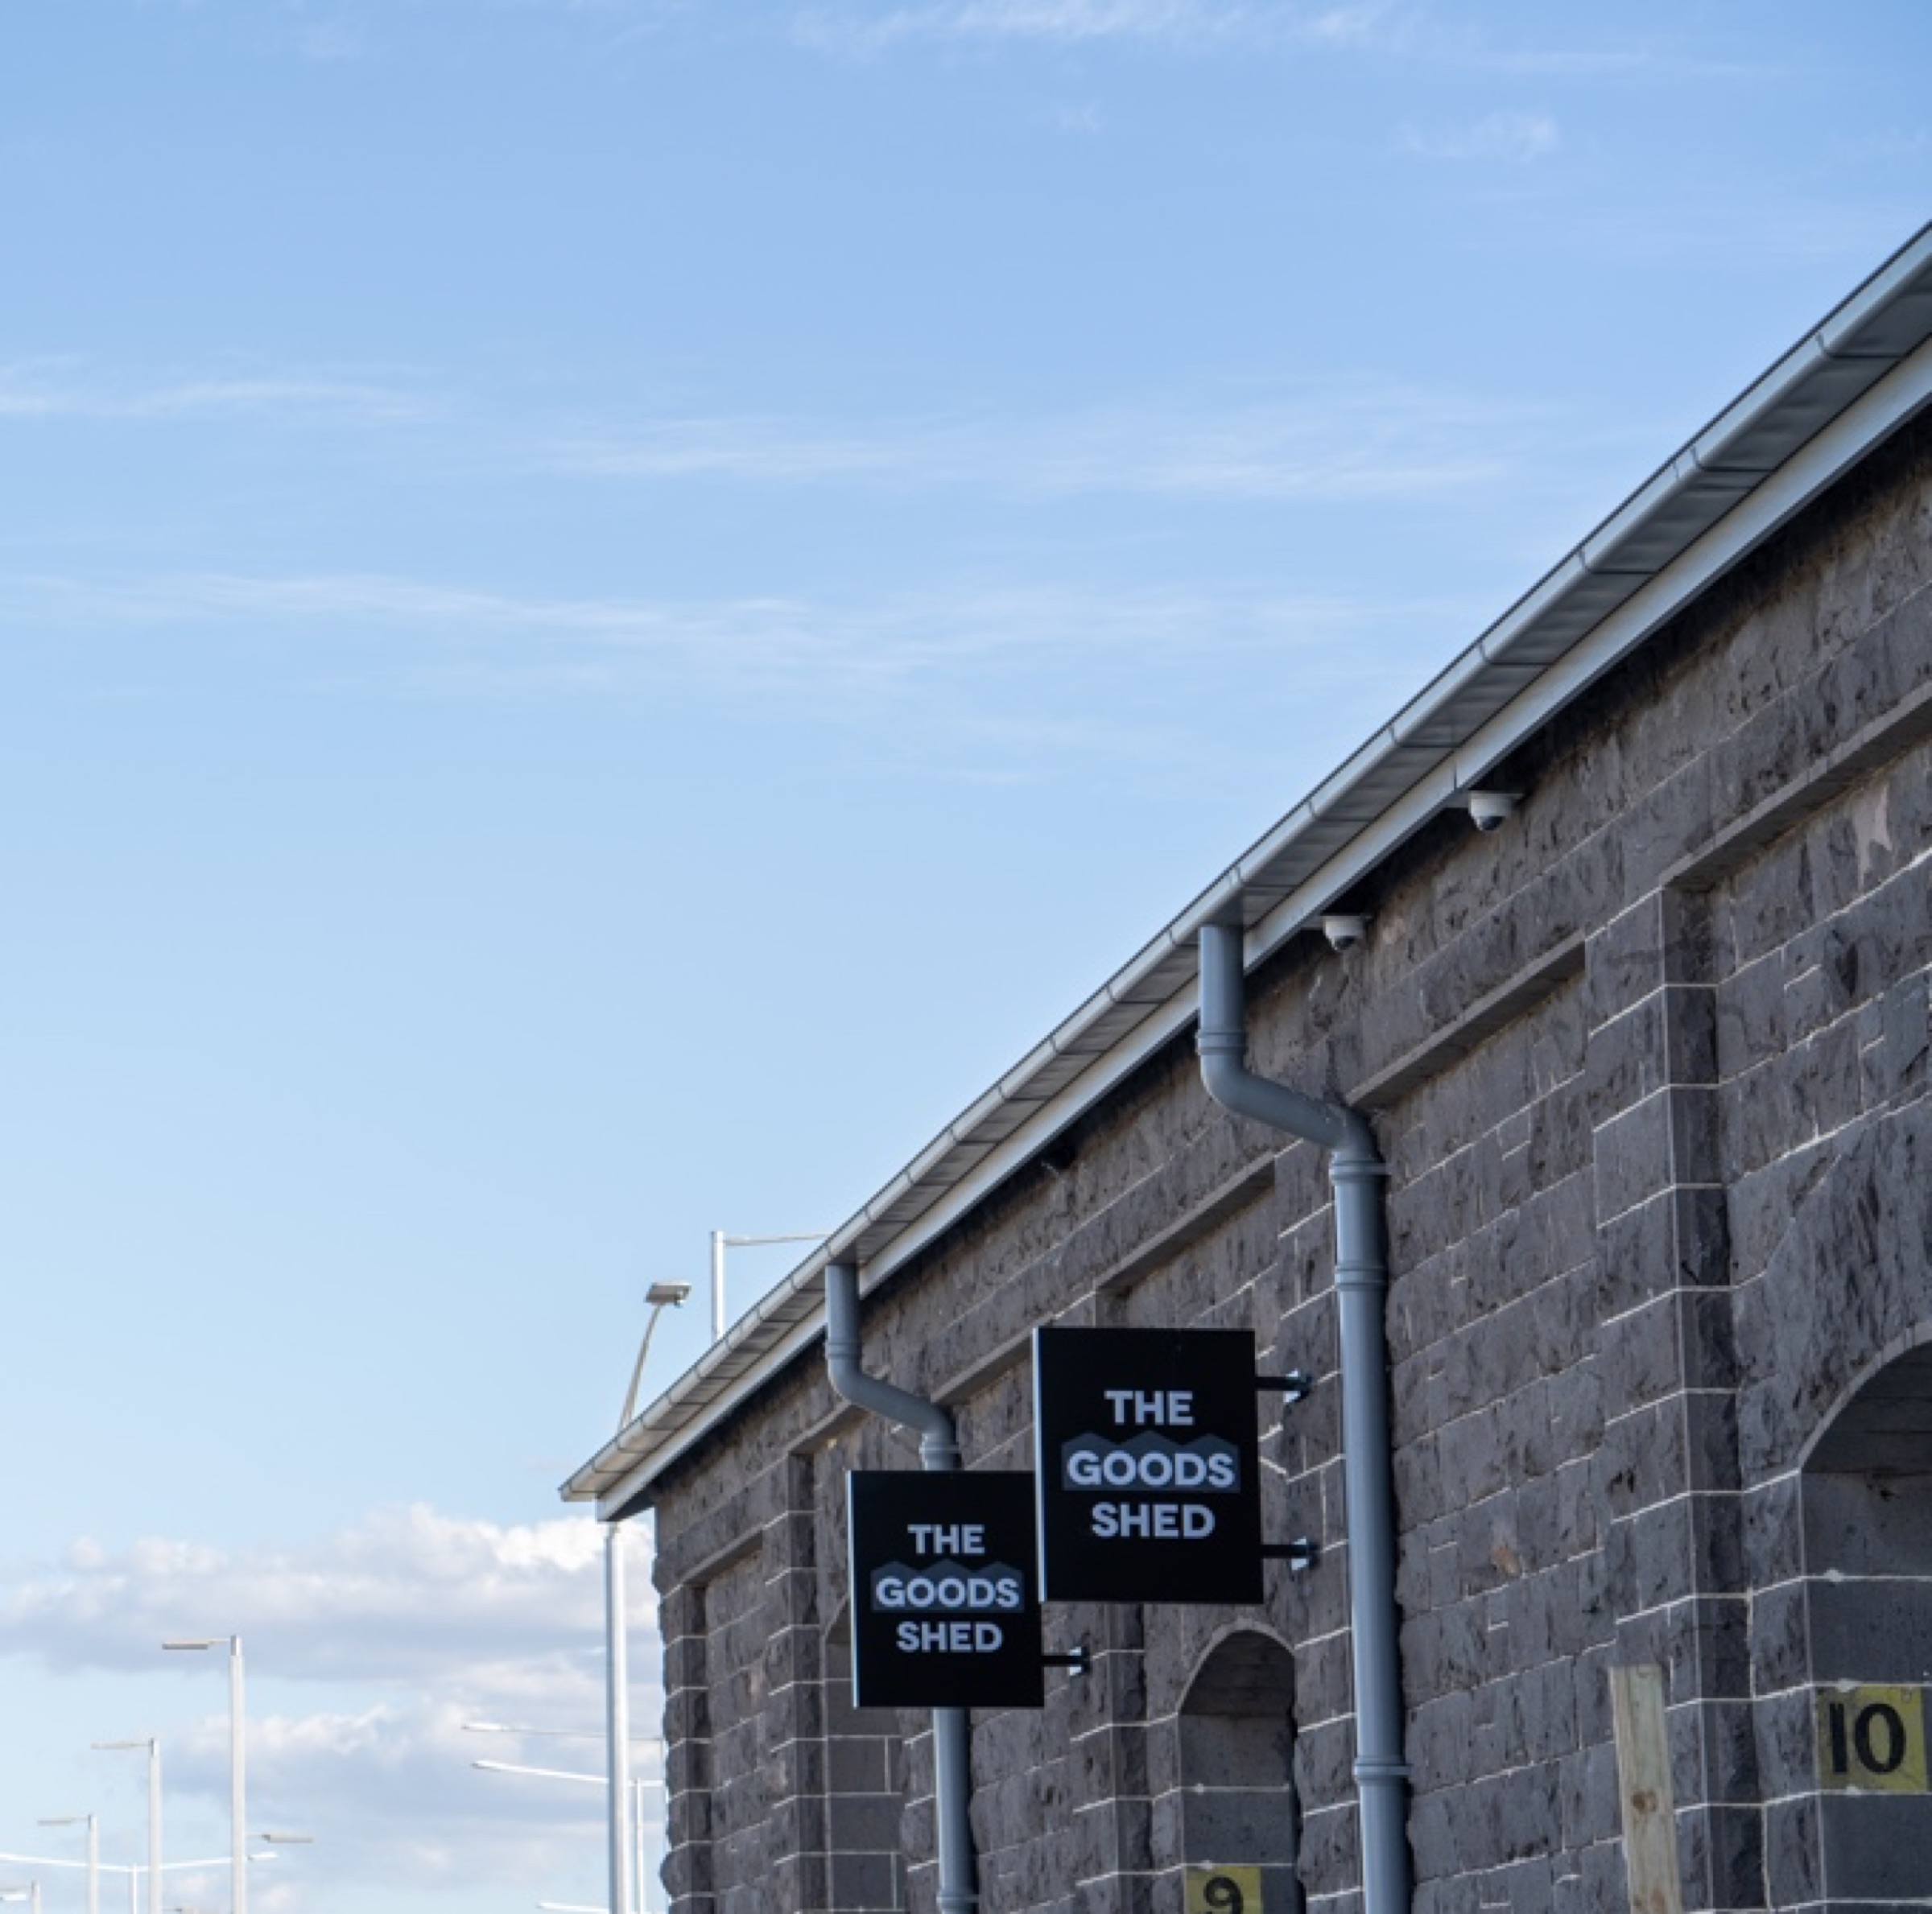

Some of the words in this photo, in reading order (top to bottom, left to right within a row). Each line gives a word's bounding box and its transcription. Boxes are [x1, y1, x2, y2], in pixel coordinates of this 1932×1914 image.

[1104, 1390, 1195, 1426] THE
[1067, 1450, 1236, 1488] GOODS
[907, 1524, 985, 1554] THE
[1091, 1502, 1216, 1540] SHED
[875, 1576, 1020, 1608] GOODS
[896, 1620, 1003, 1652] SHED
[1828, 1702, 1906, 1774] 10
[1203, 1876, 1244, 1914] 9
